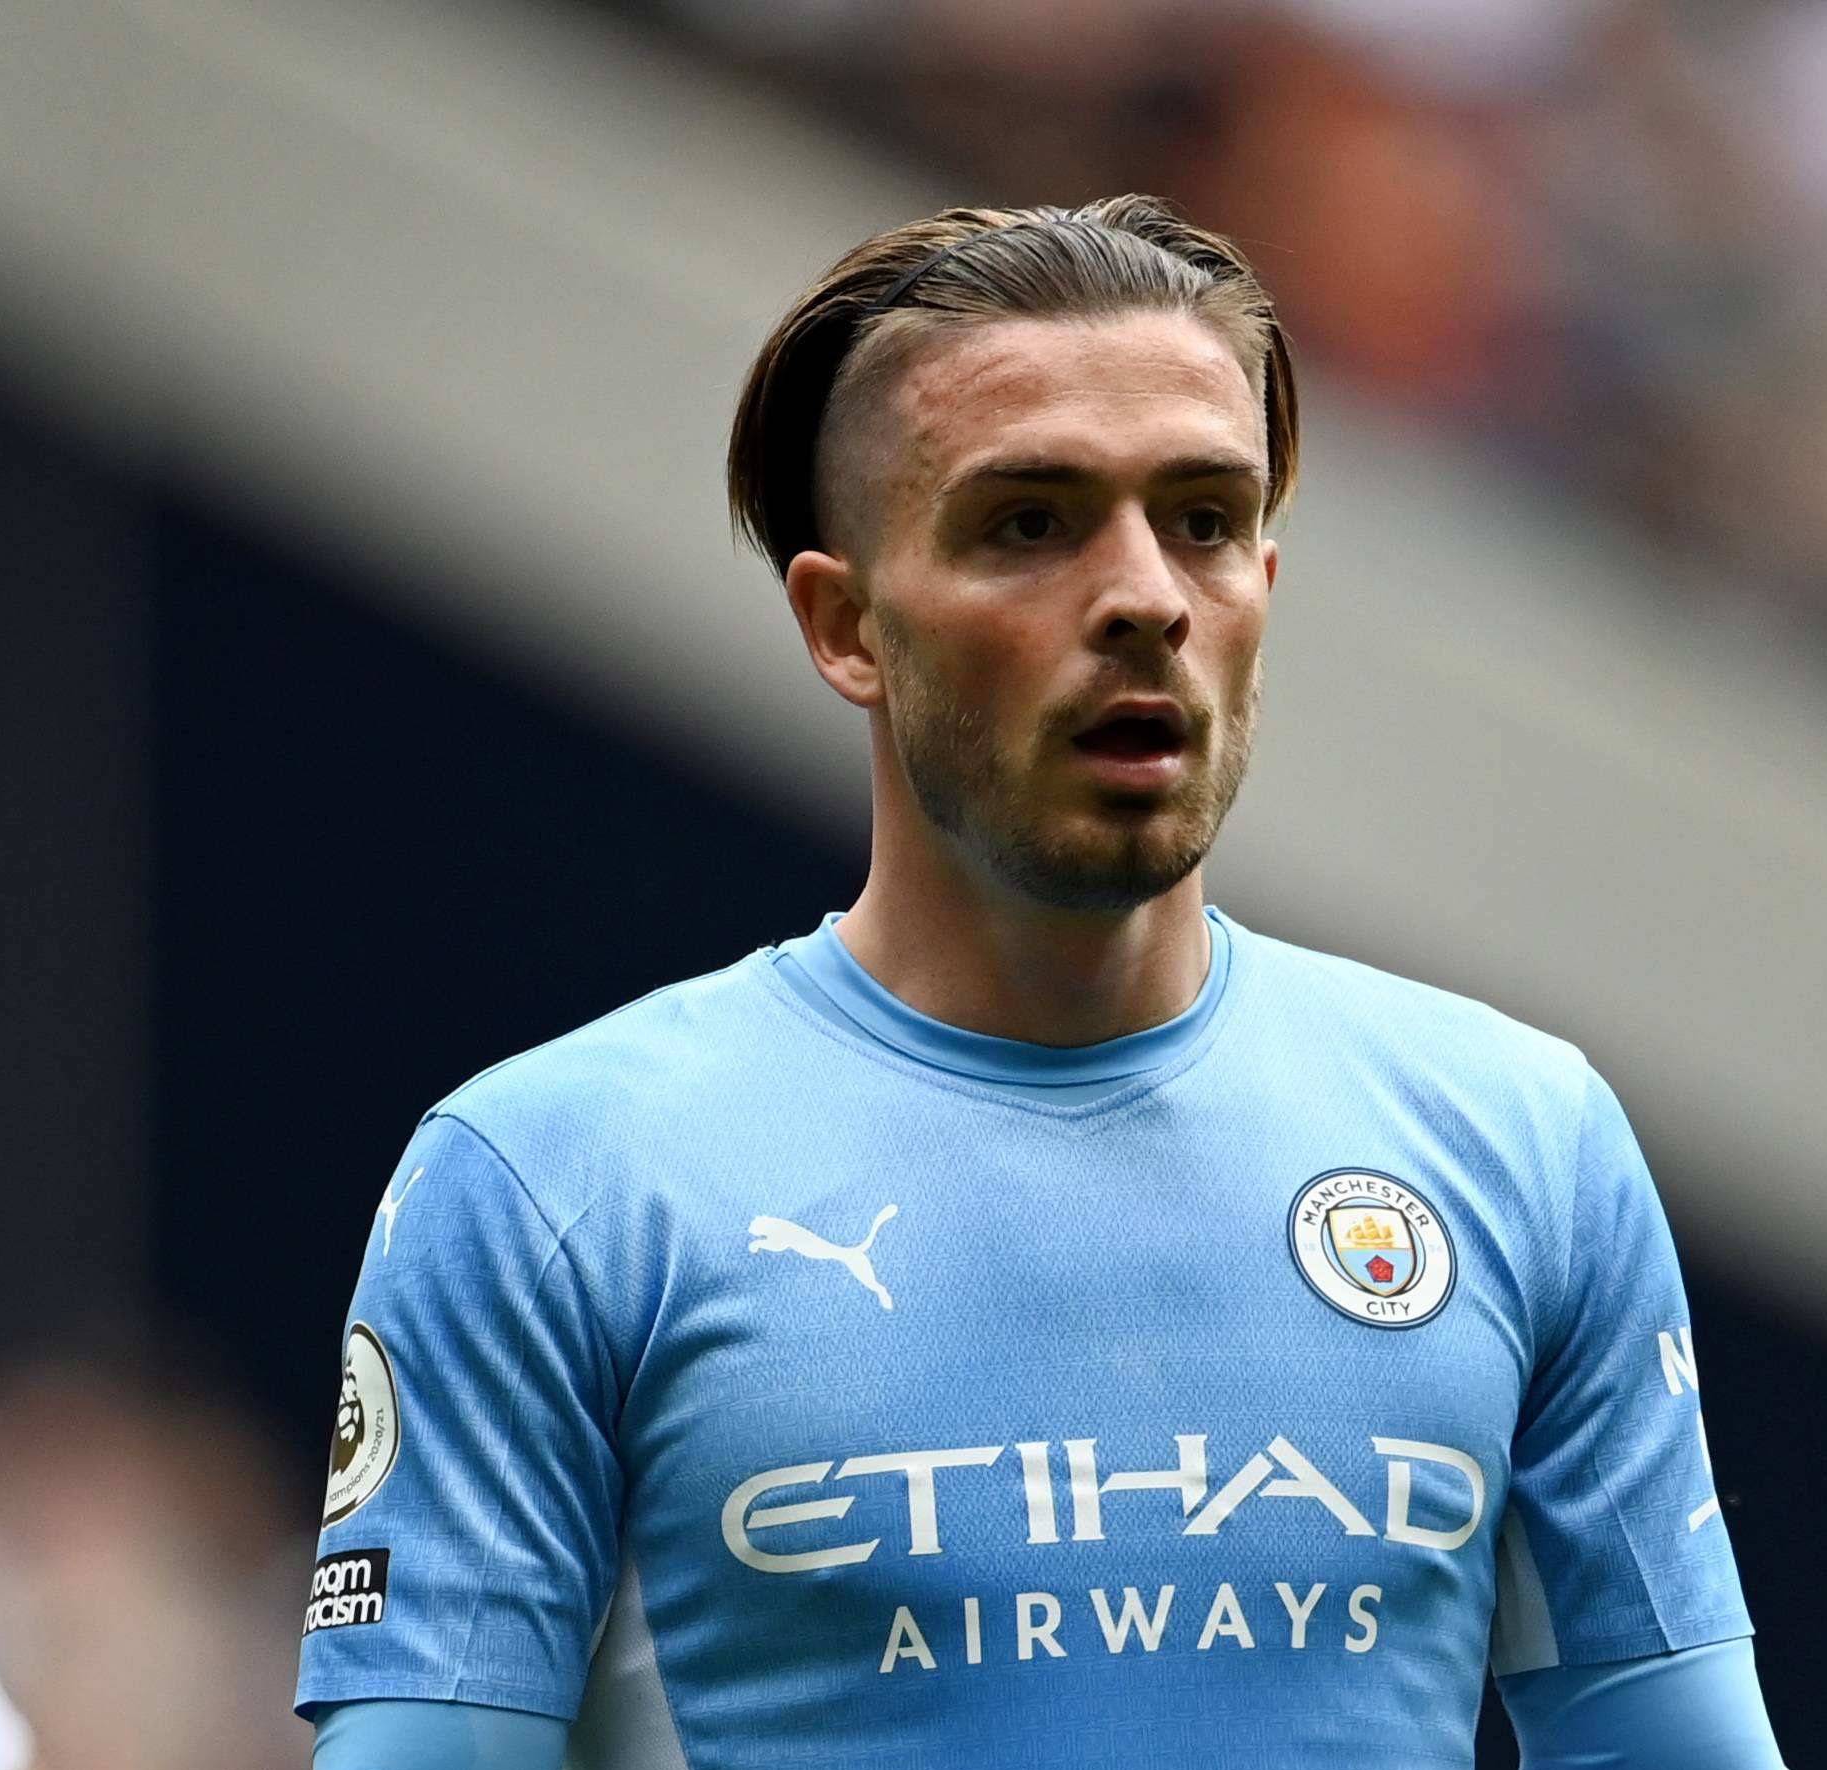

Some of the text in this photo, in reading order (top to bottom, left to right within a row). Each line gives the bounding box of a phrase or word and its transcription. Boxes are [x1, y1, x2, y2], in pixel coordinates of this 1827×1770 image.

[1303, 1180, 1430, 1227] MANCHESTER
[1366, 1301, 1410, 1316] CITY
[329, 1408, 385, 1502] ampions 2020/21
[721, 1434, 1485, 1573] ETIHAD
[879, 1582, 1383, 1674] AIRWAYS
